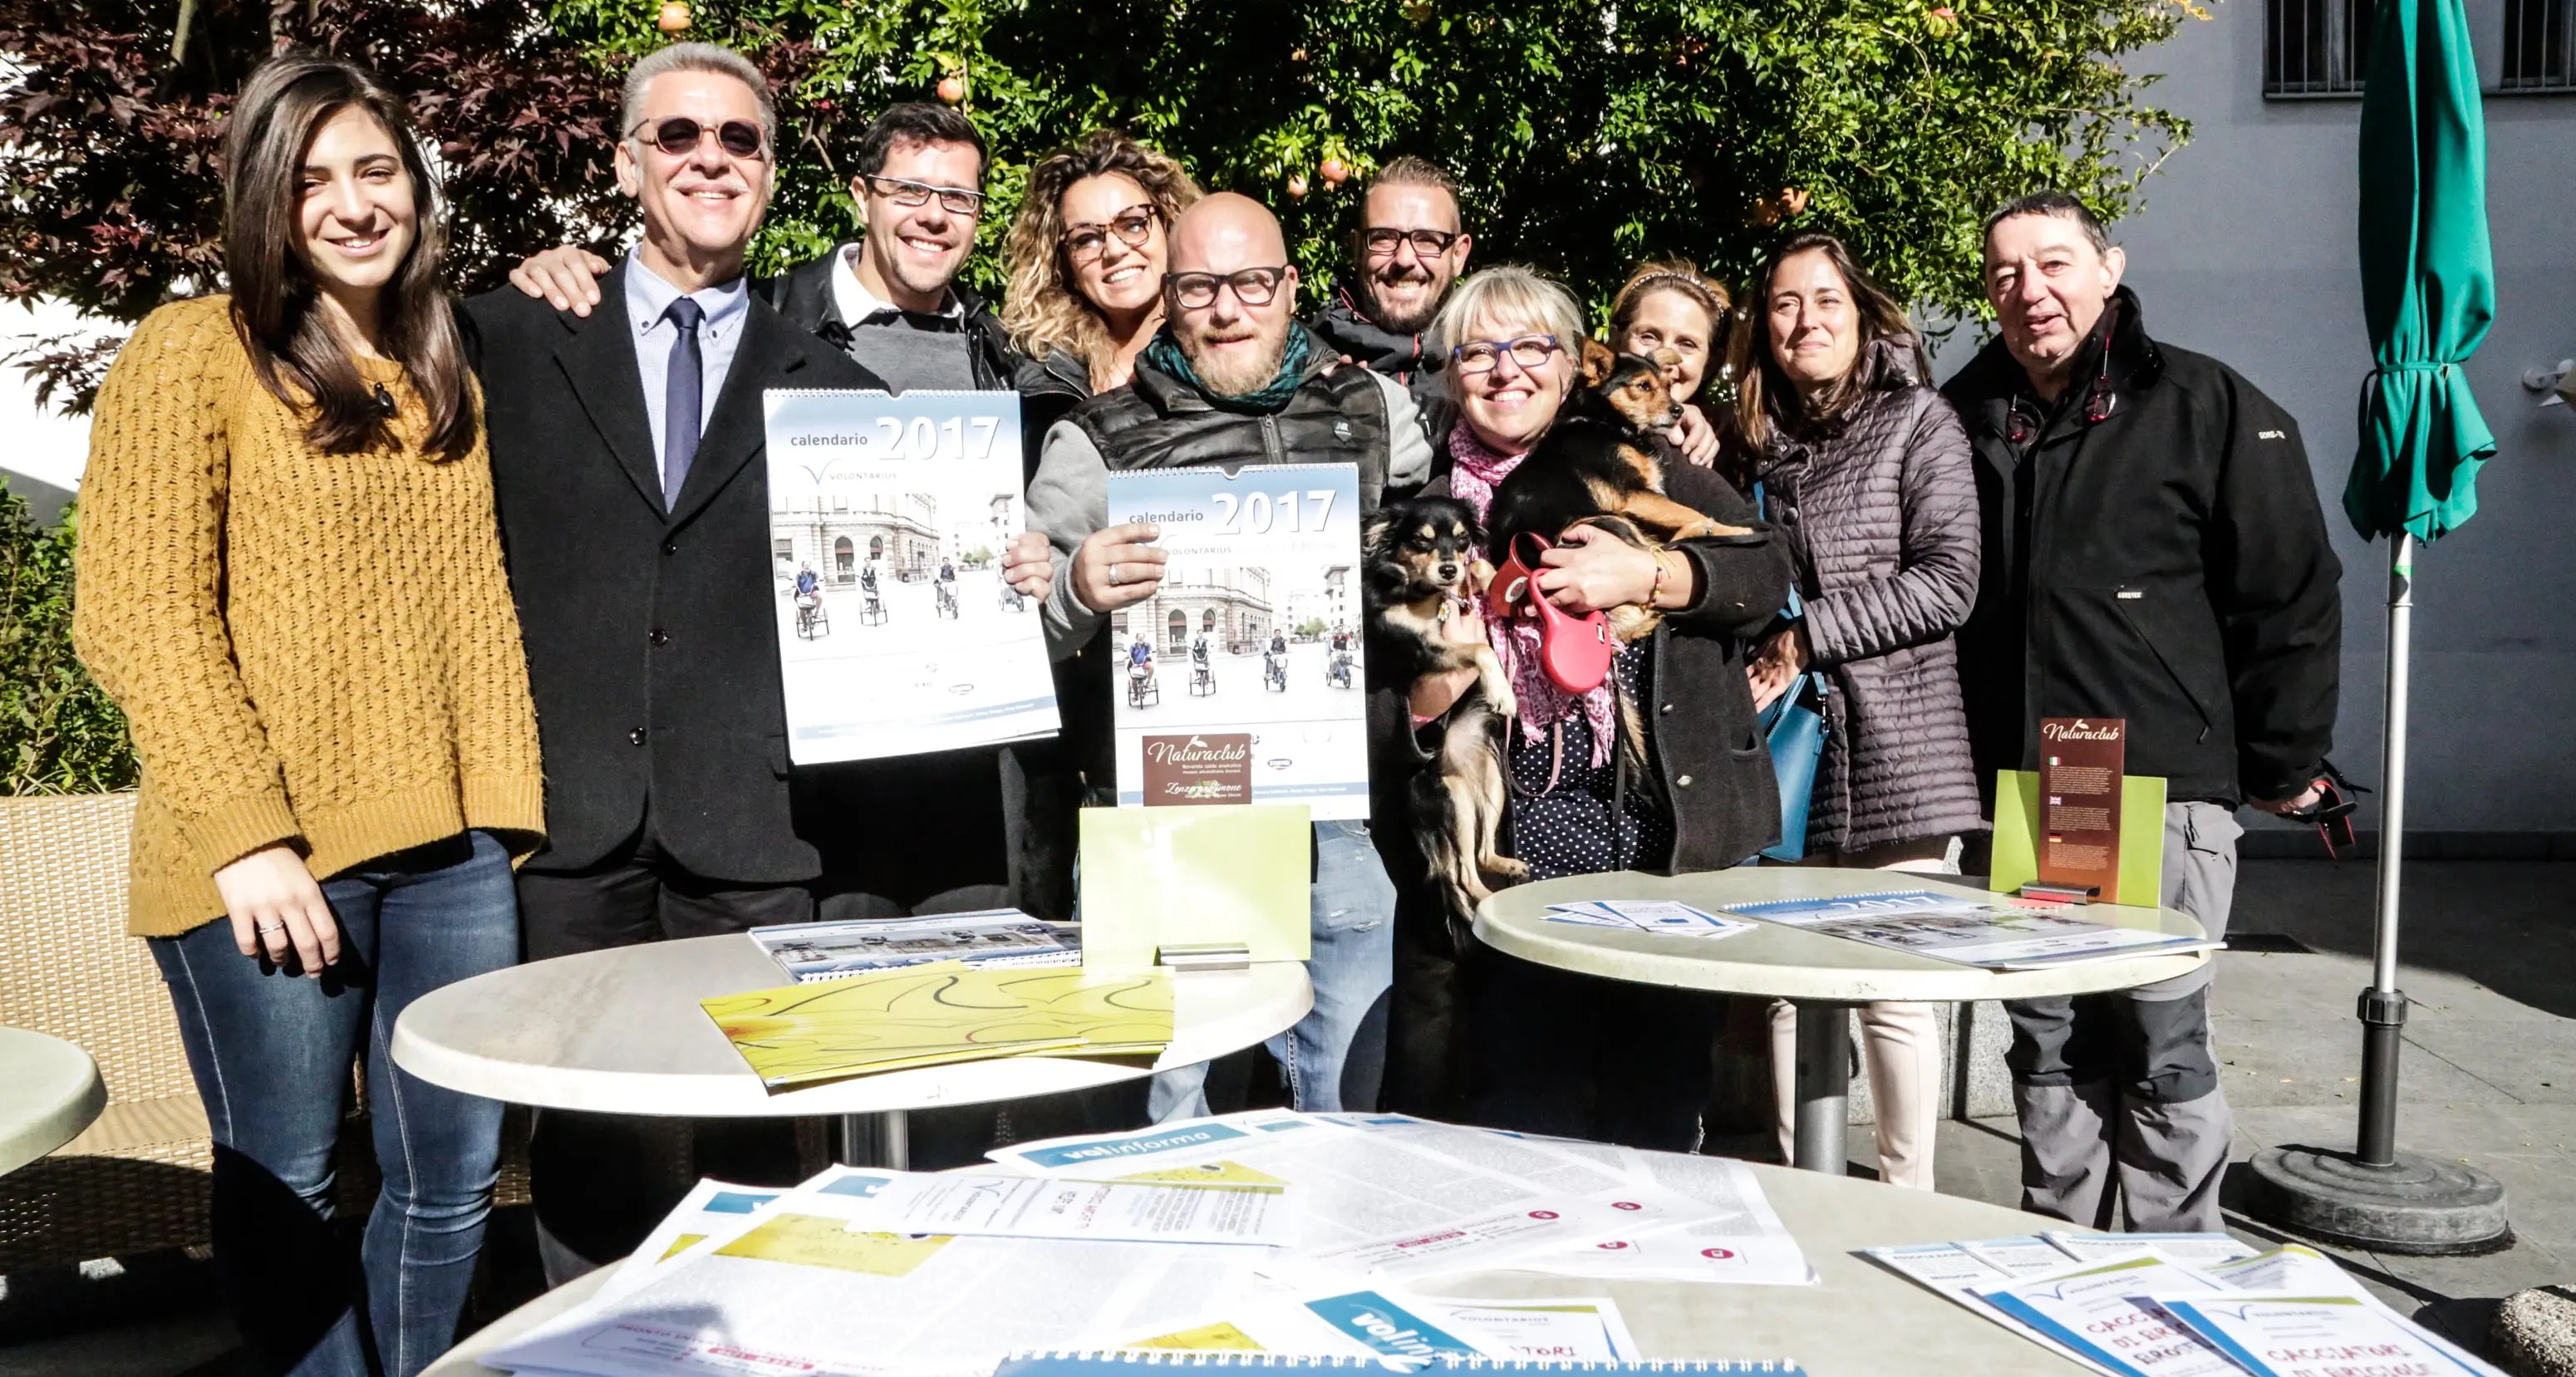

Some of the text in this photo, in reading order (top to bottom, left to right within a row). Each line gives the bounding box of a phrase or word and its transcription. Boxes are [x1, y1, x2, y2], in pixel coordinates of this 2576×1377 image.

[791, 416, 1000, 460] calendario 2017
[829, 473, 897, 481] VOLONTARIUS
[1129, 490, 1337, 535] calendario 2017
[1166, 545, 1232, 556] VOLONTARIUS
[2043, 720, 2119, 742] Naturaclub
[1148, 735, 1246, 765] Naturaclub
[1063, 1131, 1212, 1161] volinforma
[1351, 1313, 1434, 1356] volin
[2266, 1343, 2413, 1363] CACCIATORI
